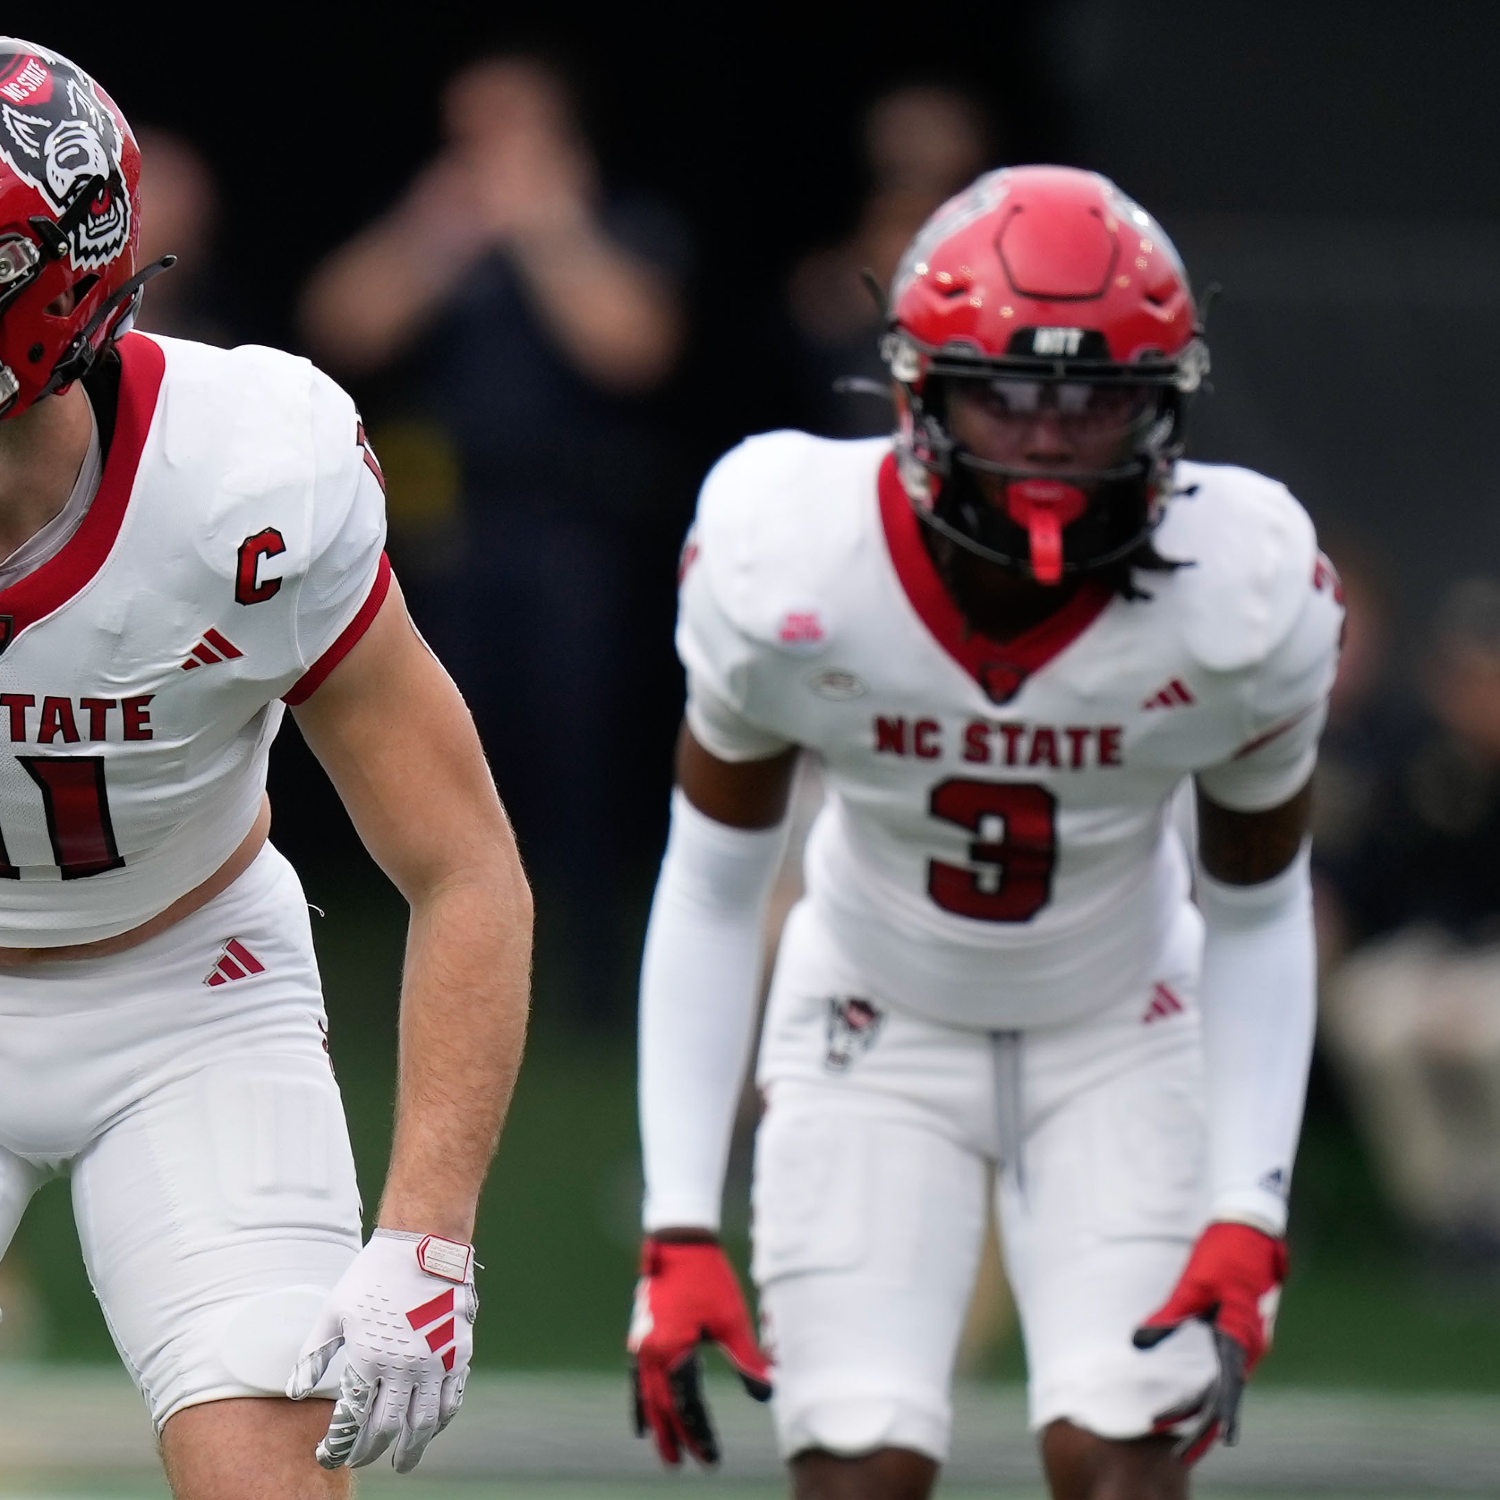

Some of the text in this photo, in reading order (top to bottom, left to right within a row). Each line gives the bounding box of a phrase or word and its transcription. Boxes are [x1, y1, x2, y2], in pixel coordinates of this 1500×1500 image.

[0, 58, 47, 102] NC STATE
[235, 526, 287, 606] C
[874, 715, 1124, 769] NC STATE
[927, 776, 1059, 923] 3
